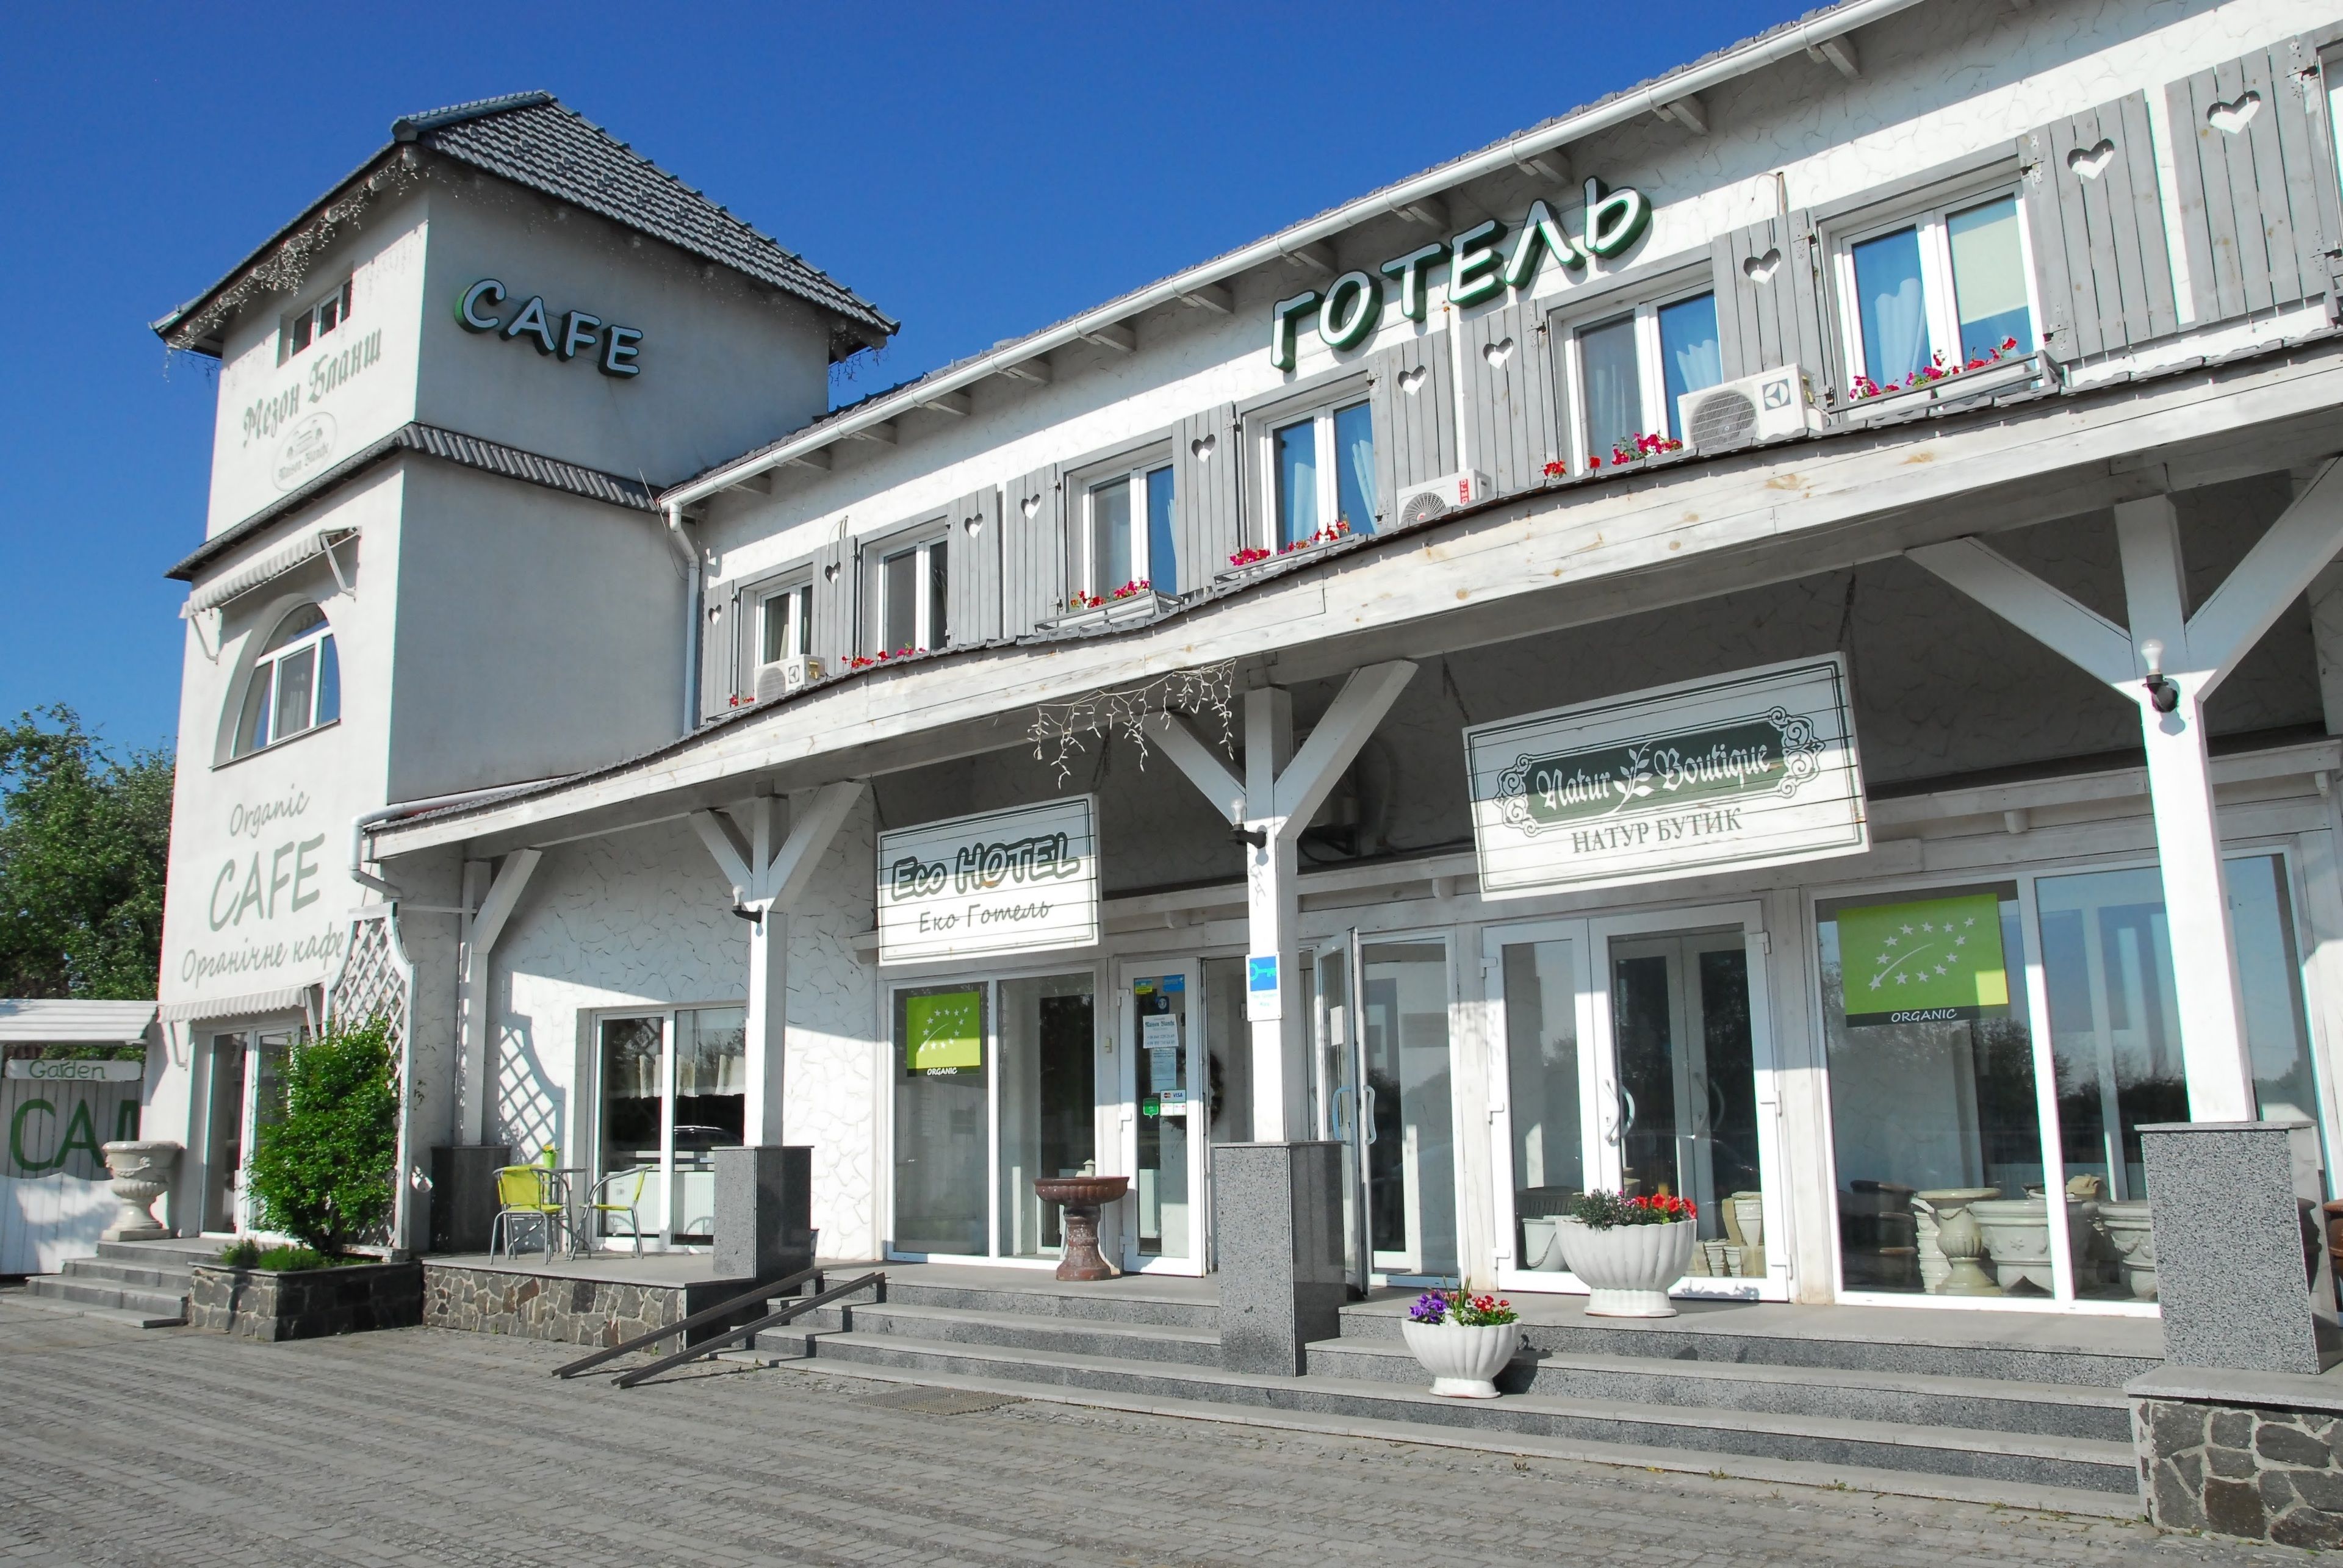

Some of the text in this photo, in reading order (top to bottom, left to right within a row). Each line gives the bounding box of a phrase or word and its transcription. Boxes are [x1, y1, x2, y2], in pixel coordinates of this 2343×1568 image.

[1271, 175, 1652, 373] ГОТЕЛЬ
[455, 278, 643, 379] CAFE
[243, 328, 382, 448] Мезон Бланш
[1536, 743, 1771, 810] Natur Boutique
[230, 783, 311, 838] Organic
[1571, 808, 1743, 854] НАТУР БУТИК
[209, 833, 325, 932] CAFE
[956, 832, 1081, 894] HOTEL
[920, 901, 1054, 933] Еко Готель
[182, 922, 344, 989] Органічне кафе
[1891, 1009, 1957, 1023] ORGANIC
[29, 1060, 106, 1079] Garden
[926, 1066, 958, 1076] ORGANIC
